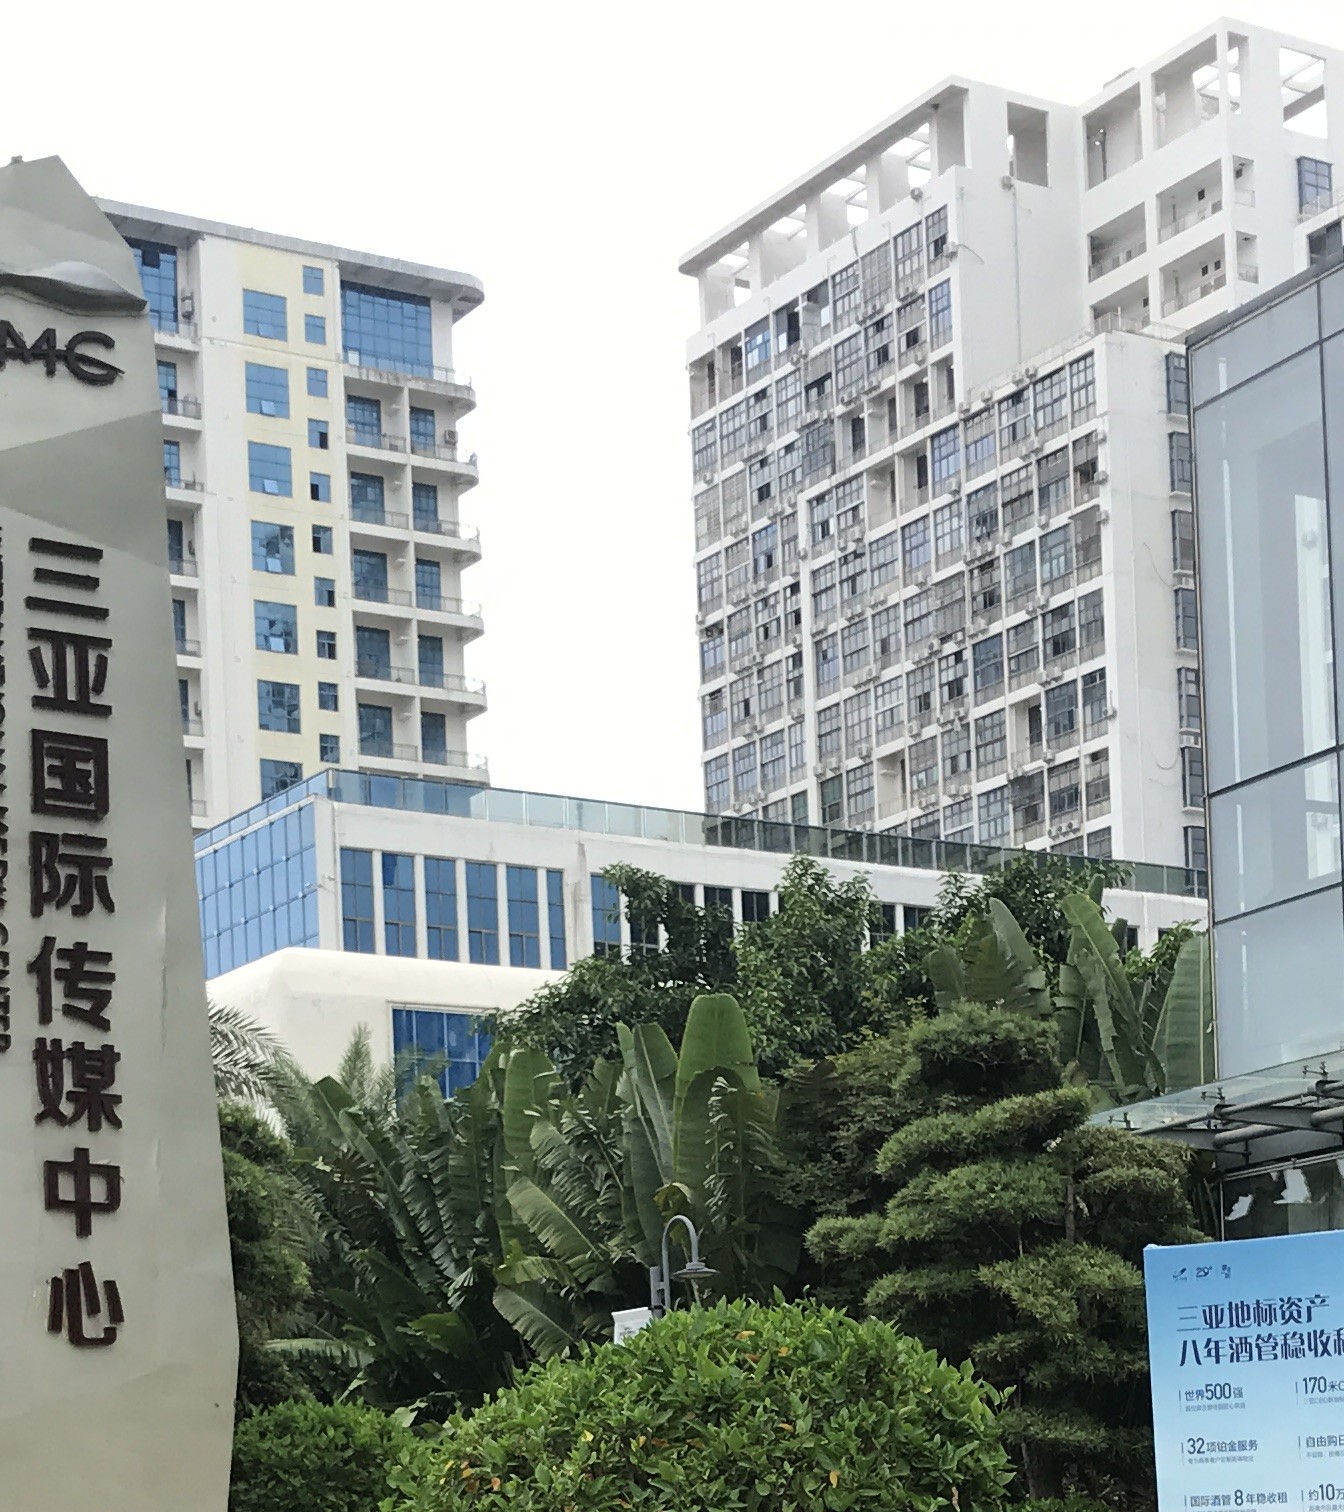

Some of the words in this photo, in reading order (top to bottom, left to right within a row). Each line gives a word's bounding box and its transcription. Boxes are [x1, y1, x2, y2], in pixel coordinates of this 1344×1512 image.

[22, 536, 125, 1347] 三亚国际传媒中心
[1176, 1294, 1331, 1332] 三亚地标资产
[1184, 1382, 1244, 1401] 世界500强
